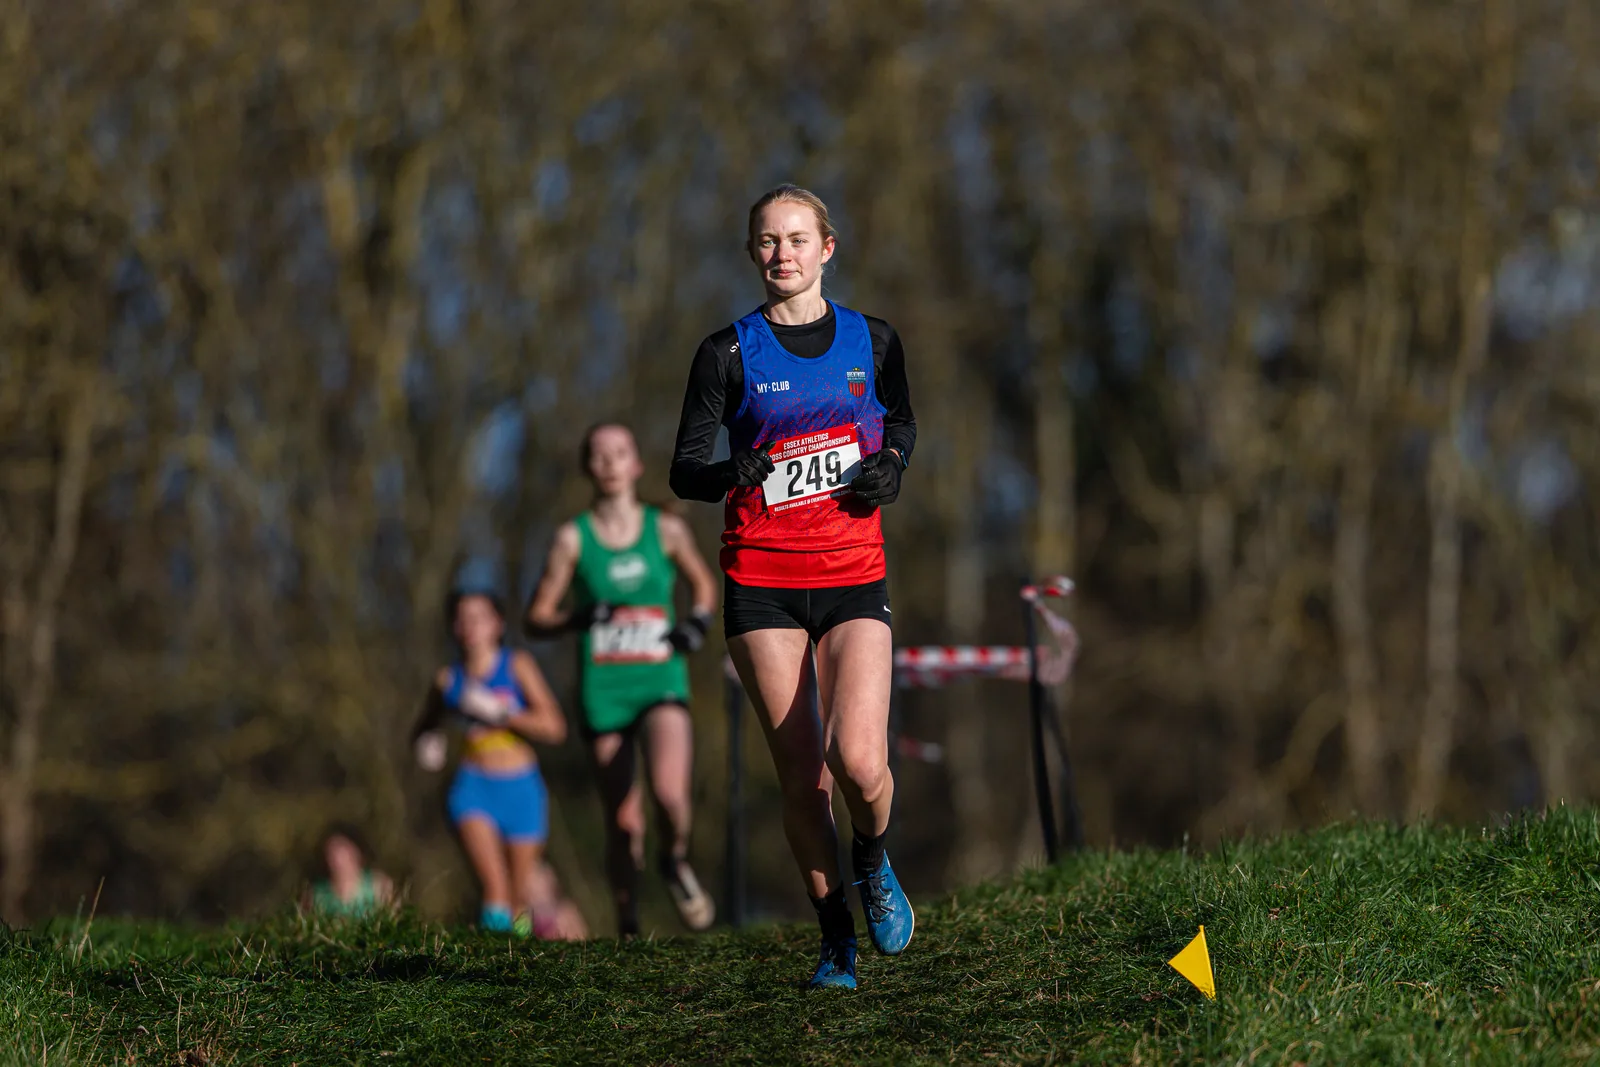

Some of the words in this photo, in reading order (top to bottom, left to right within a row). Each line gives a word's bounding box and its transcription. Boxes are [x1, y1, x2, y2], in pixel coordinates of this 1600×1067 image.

[782, 446, 808, 458] COUNTRY
[808, 435, 851, 452] CHAMPIONSHIPS
[783, 439, 801, 450] ESSEX
[801, 432, 829, 446] ATHLETICS
[786, 450, 841, 498] 249
